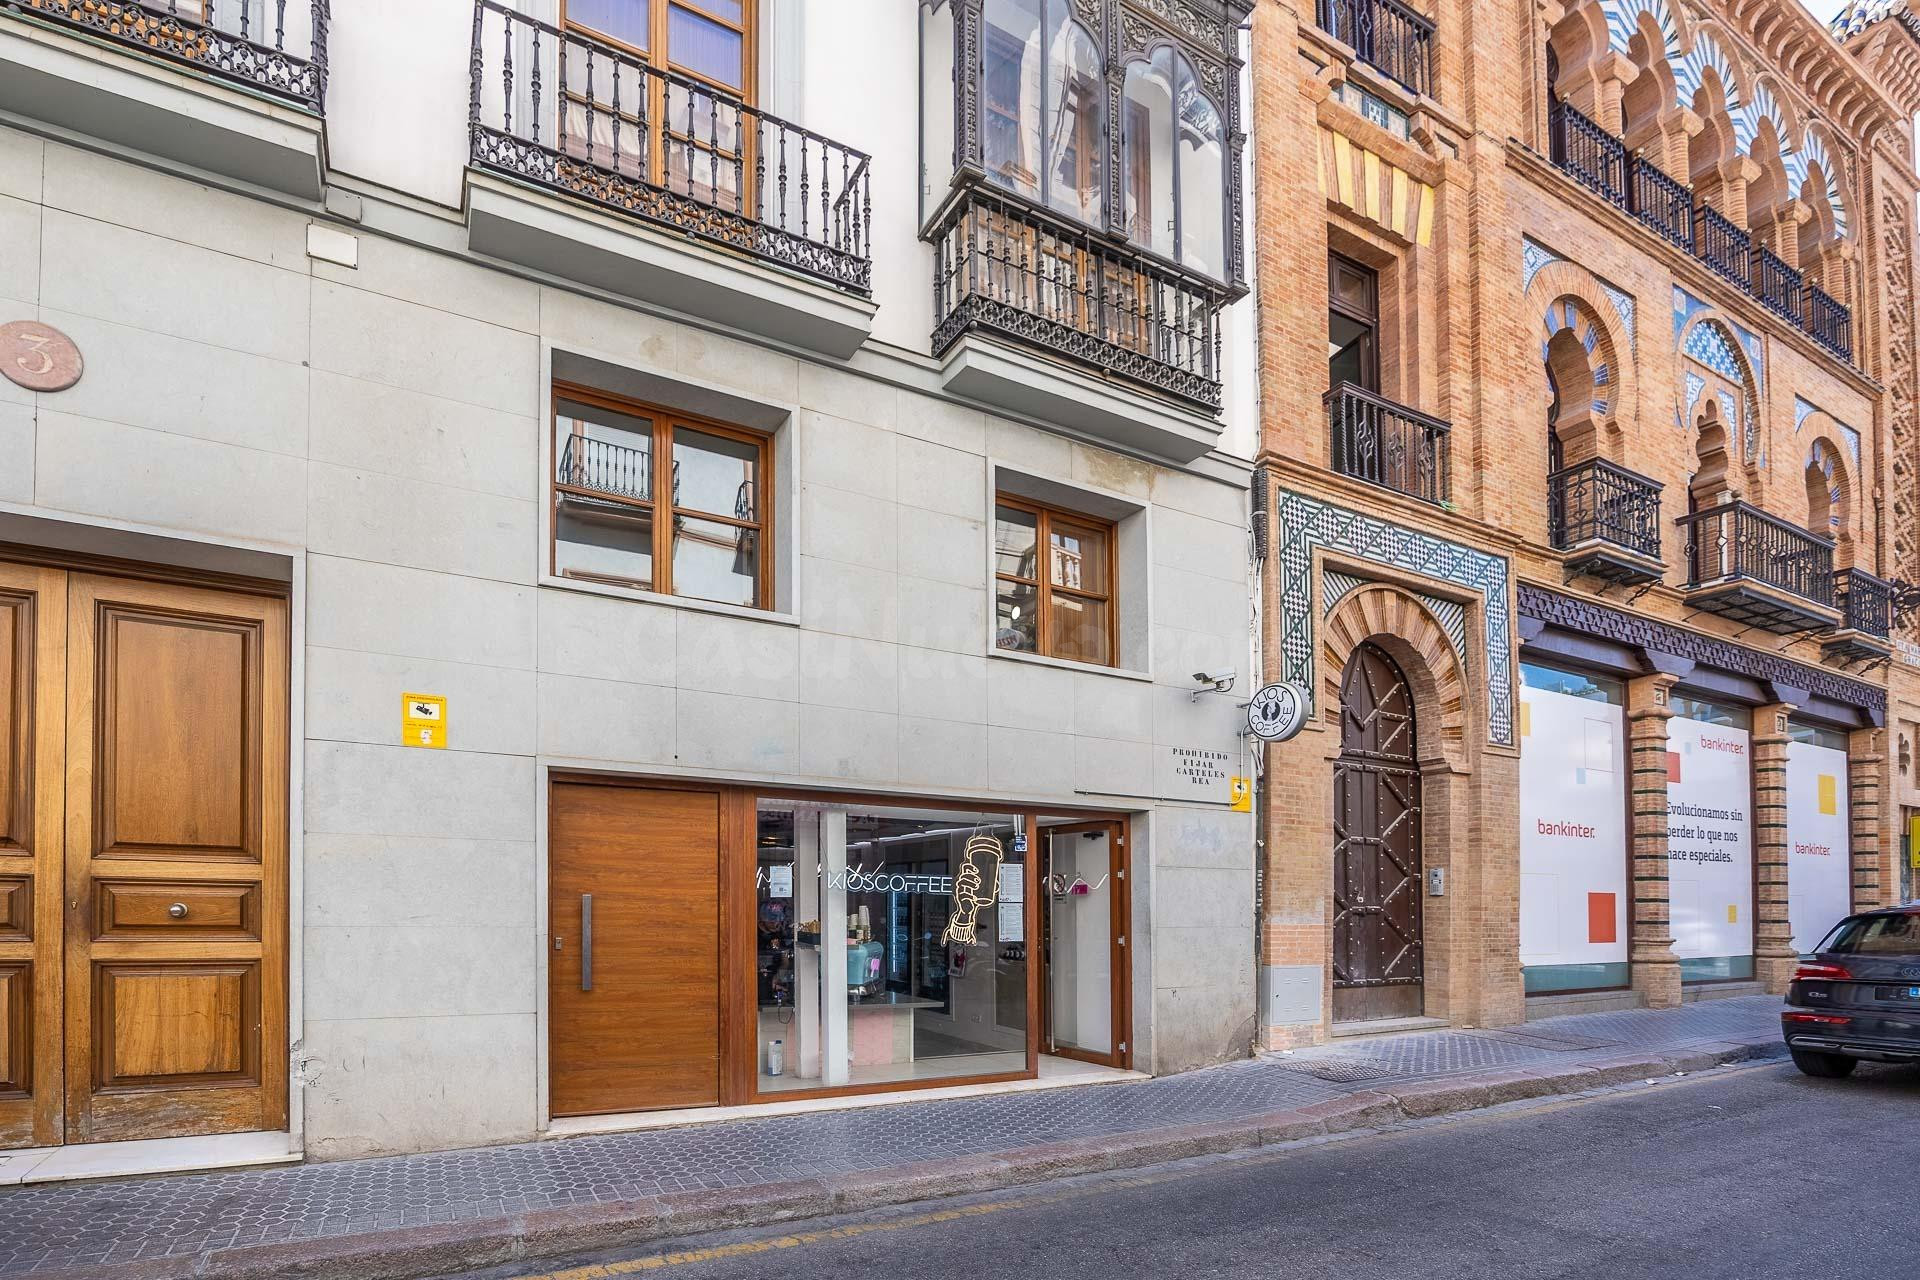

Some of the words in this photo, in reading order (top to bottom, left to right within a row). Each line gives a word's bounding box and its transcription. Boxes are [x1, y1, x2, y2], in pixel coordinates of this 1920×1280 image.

[17, 333, 53, 375] 3
[1253, 687, 1287, 709] KIOS
[1251, 706, 1293, 733] COFFEE
[1172, 747, 1228, 760] PROHIBIDO
[1183, 758, 1213, 769] FIJAR
[1176, 767, 1225, 779] CARTELES
[1192, 776, 1210, 786] REA
[1730, 808, 1743, 821] sin
[1697, 826, 1705, 840] lo
[1707, 830, 1722, 844] que
[1724, 831, 1738, 842] nos
[1689, 848, 1733, 866] especiales.
